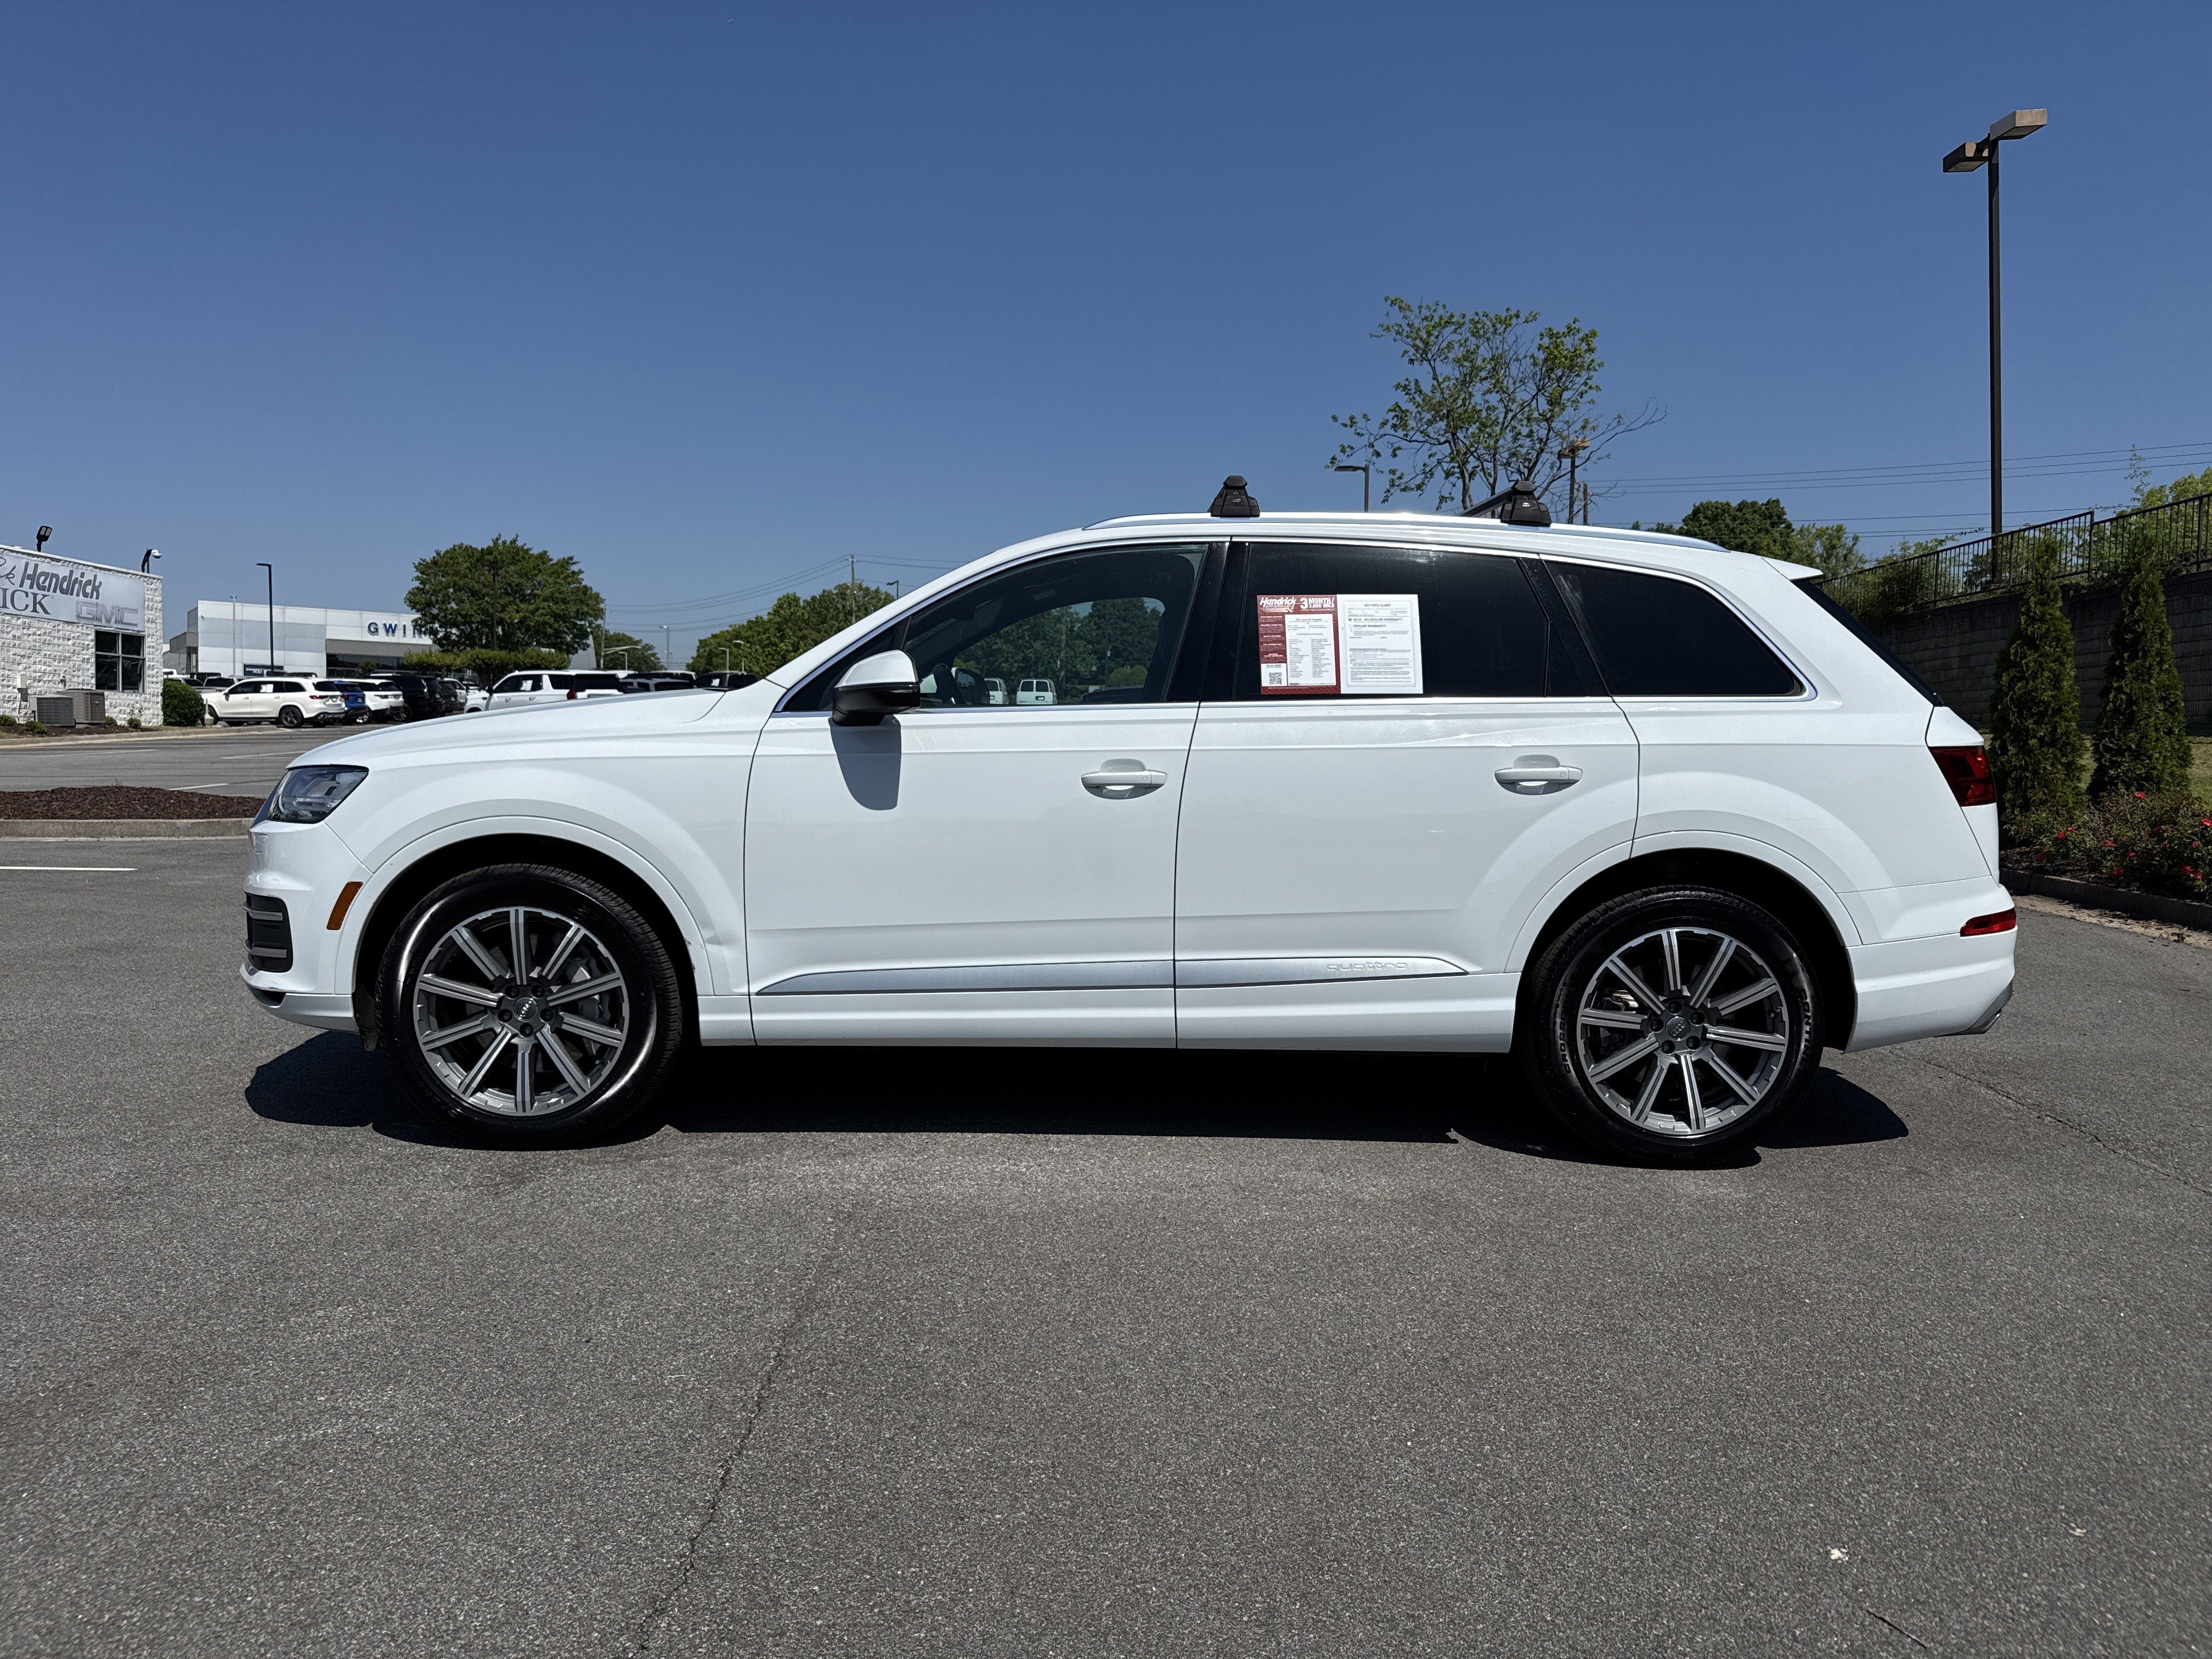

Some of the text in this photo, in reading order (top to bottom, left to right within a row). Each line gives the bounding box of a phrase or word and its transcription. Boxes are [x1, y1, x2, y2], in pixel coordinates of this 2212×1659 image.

[19, 561, 102, 600] Hendrick
[1260, 597, 1296, 607] Hendrick
[1300, 598, 1308, 609] 3
[76, 601, 138, 628] GMC
[1327, 962, 1408, 973] quattro
